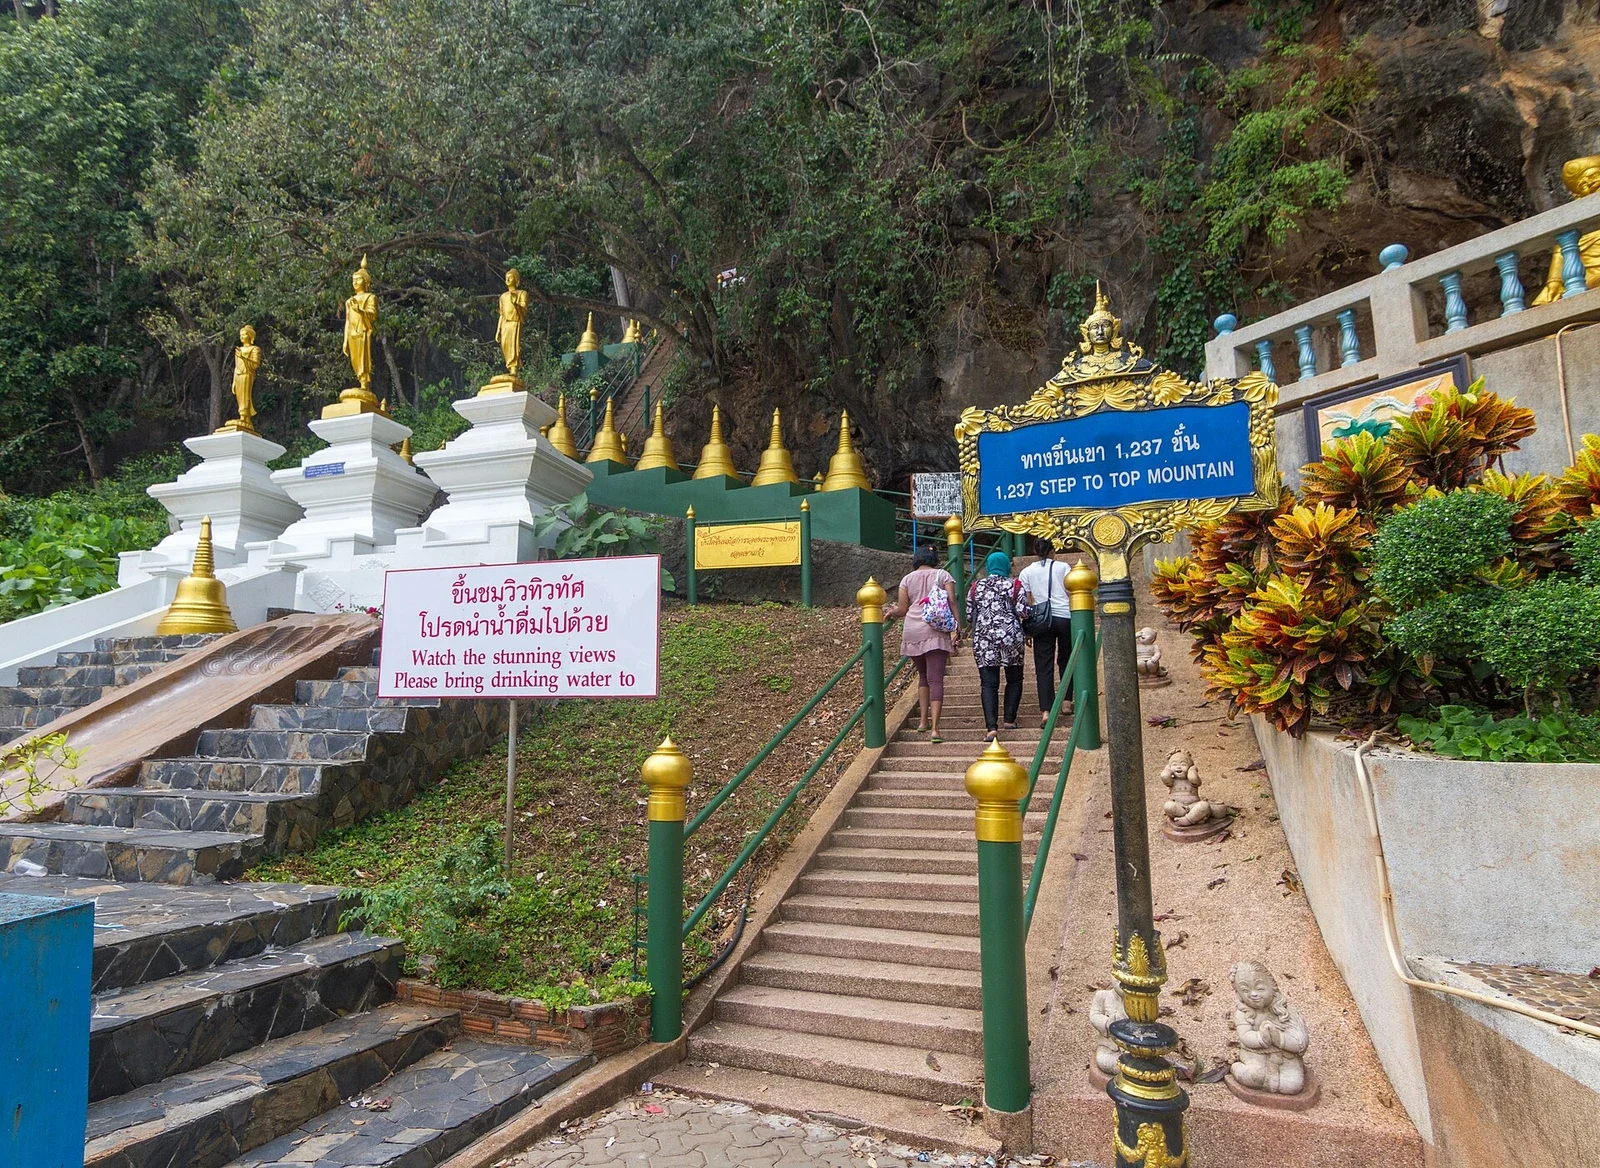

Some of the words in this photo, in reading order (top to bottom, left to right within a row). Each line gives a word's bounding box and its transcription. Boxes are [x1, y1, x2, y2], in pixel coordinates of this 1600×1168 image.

[1021, 437, 1105, 469] ทางขึ้นเขา
[1116, 439, 1162, 458] 1,237
[1172, 424, 1200, 452] ขั้น
[996, 482, 1034, 499] 1,237
[1041, 478, 1077, 494] STEP
[1083, 475, 1103, 490] TO
[1110, 471, 1141, 487] TOP
[1148, 461, 1234, 483] MOUNTAIN
[452, 574, 584, 604] ขึ้นชมวิวทิวทัศ
[419, 604, 608, 637] โปรดนำน้ำดื่มไปด้วย
[412, 649, 456, 665] Watch
[464, 648, 486, 665] the
[493, 647, 561, 669] stunning
[569, 646, 616, 662] views
[394, 672, 438, 688] Please
[445, 672, 485, 693] bring
[491, 670, 559, 693] drinking
[567, 672, 612, 687] water
[620, 671, 636, 687] to
